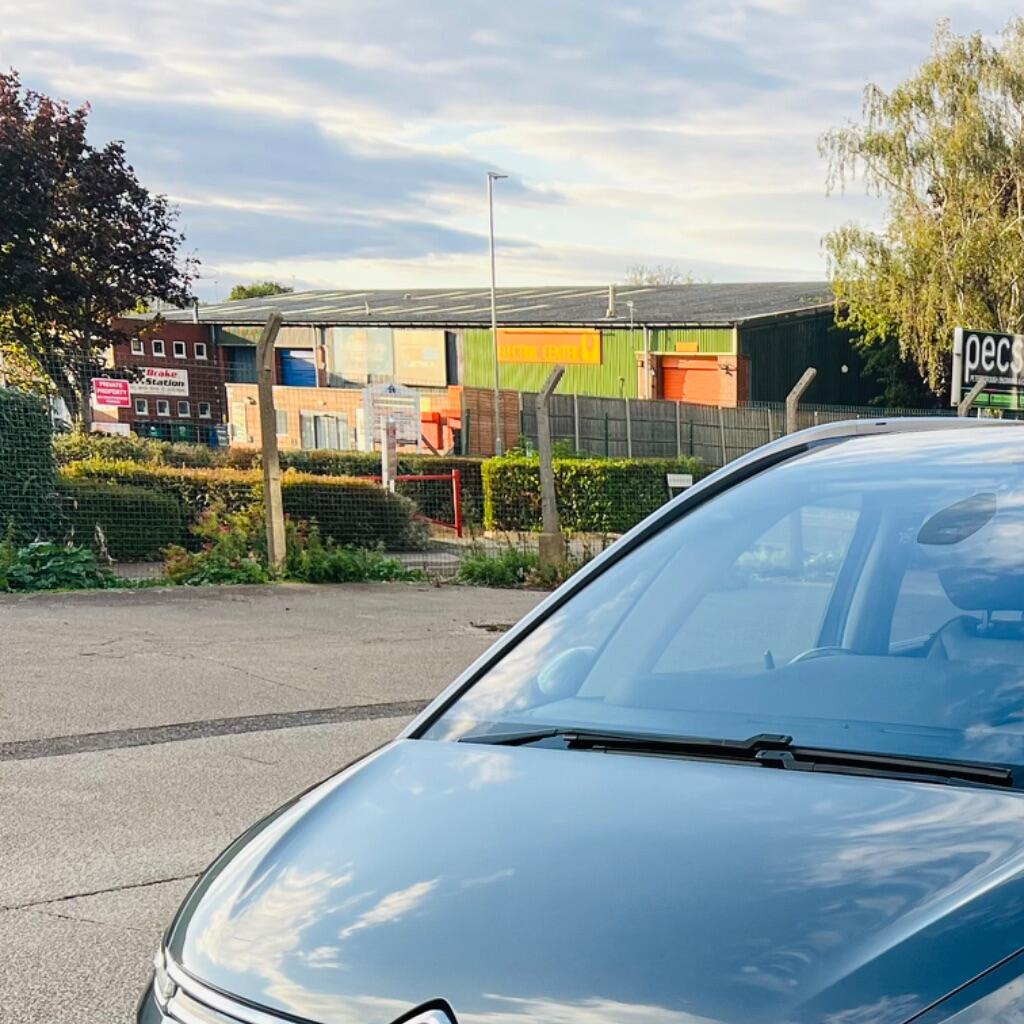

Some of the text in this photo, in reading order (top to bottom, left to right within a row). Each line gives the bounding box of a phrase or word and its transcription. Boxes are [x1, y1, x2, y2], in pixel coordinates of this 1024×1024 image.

[965, 334, 1024, 382] pecs
[146, 368, 177, 378] Brake
[146, 377, 185, 387] Station
